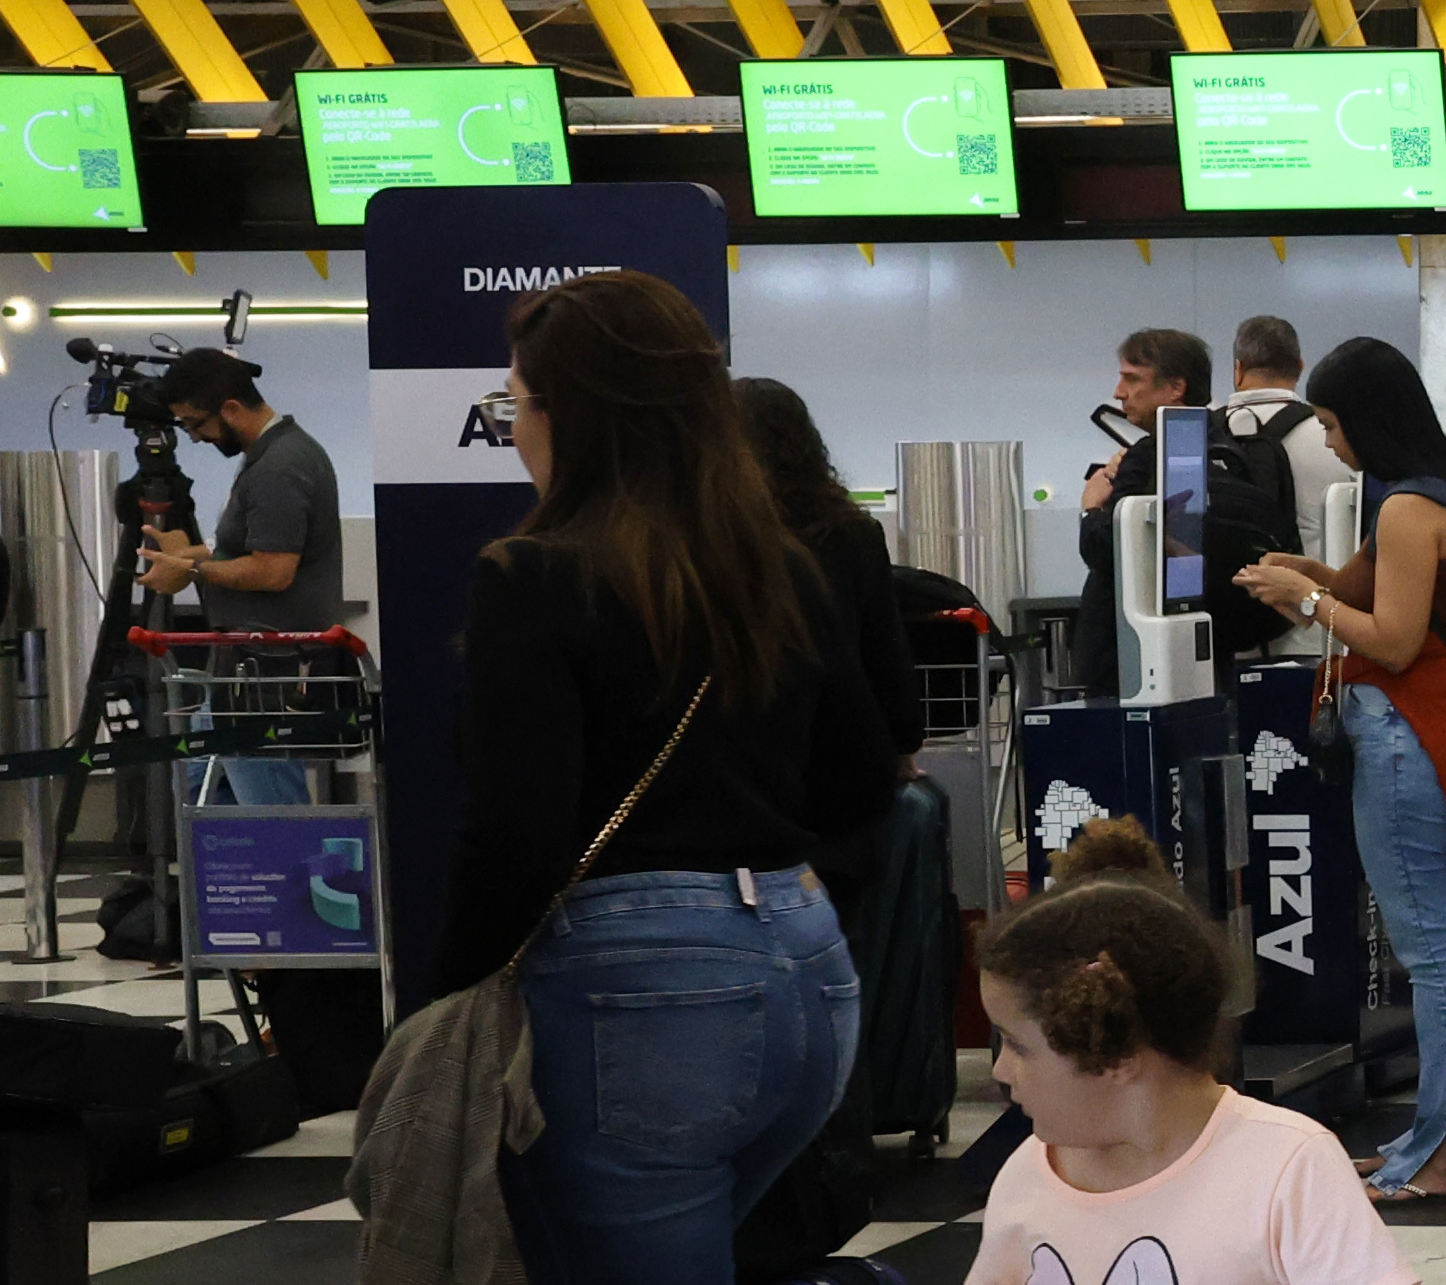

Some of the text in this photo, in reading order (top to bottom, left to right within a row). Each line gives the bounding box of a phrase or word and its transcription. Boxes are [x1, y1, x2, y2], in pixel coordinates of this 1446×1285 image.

[1193, 75, 1265, 88] WI-FI GRÁTIS
[763, 82, 833, 95] WI-FI GRÁTIS
[317, 92, 388, 104] WI-FI GRÁTIS
[1169, 767, 1183, 833] Azul
[1252, 814, 1315, 976] Azul
